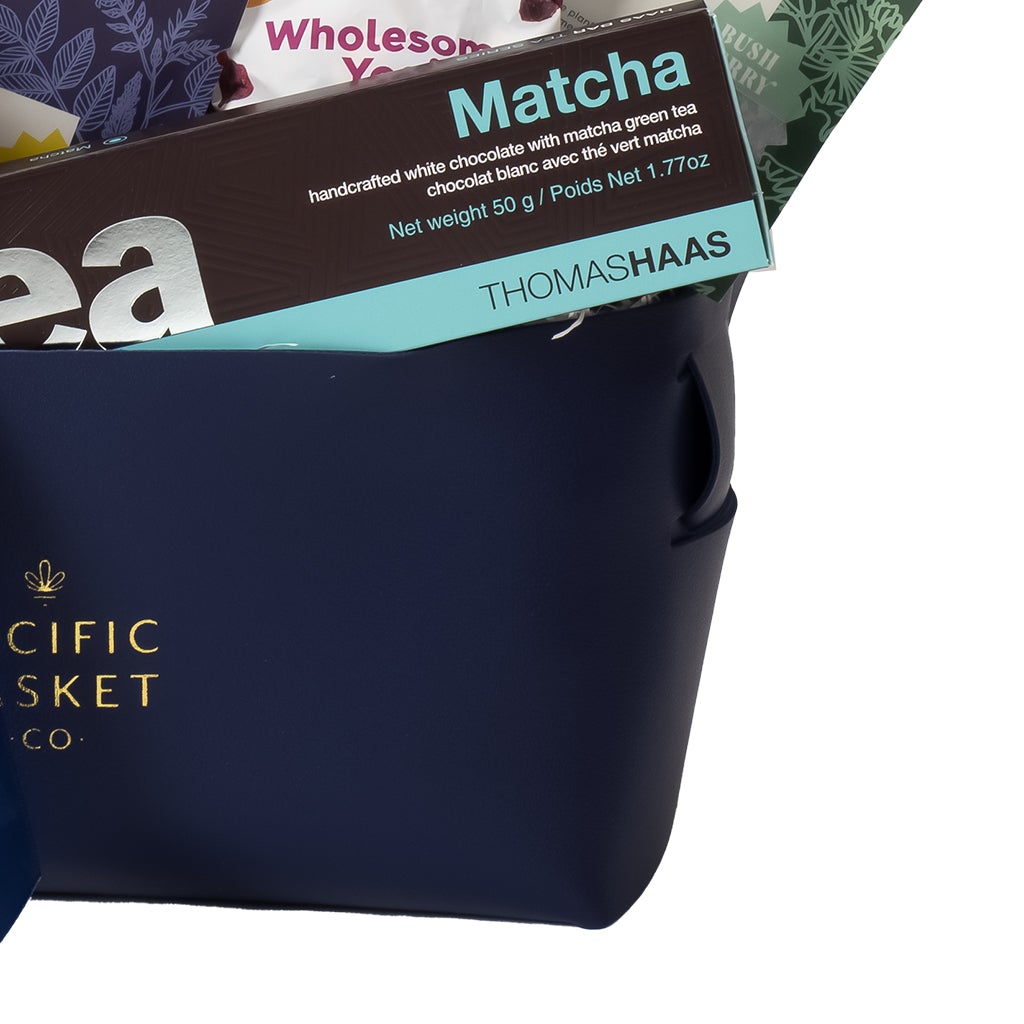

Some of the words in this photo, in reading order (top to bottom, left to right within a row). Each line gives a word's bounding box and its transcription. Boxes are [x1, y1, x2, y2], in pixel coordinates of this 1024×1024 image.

[721, 23, 780, 72] BUSH
[448, 50, 692, 139] Matcha
[308, 169, 402, 203] handcrafted
[404, 160, 446, 183] white
[449, 142, 525, 170] chocolate
[527, 134, 561, 153] with
[563, 120, 622, 144] matcha
[625, 109, 669, 132] green
[671, 102, 698, 119] tea
[426, 170, 494, 198] chocolat
[495, 160, 539, 182] blanc
[542, 153, 579, 171] avec
[581, 142, 608, 161] thé
[609, 136, 641, 153] vert
[643, 123, 703, 147] matcha
[388, 218, 423, 240] Net
[426, 202, 489, 229] weight
[492, 195, 516, 216] 50
[521, 194, 535, 213] g
[550, 178, 604, 203] Poids
[607, 167, 643, 189] Net
[646, 153, 711, 179] 1.77oz
[478, 230, 732, 310] THOMASHAAS
